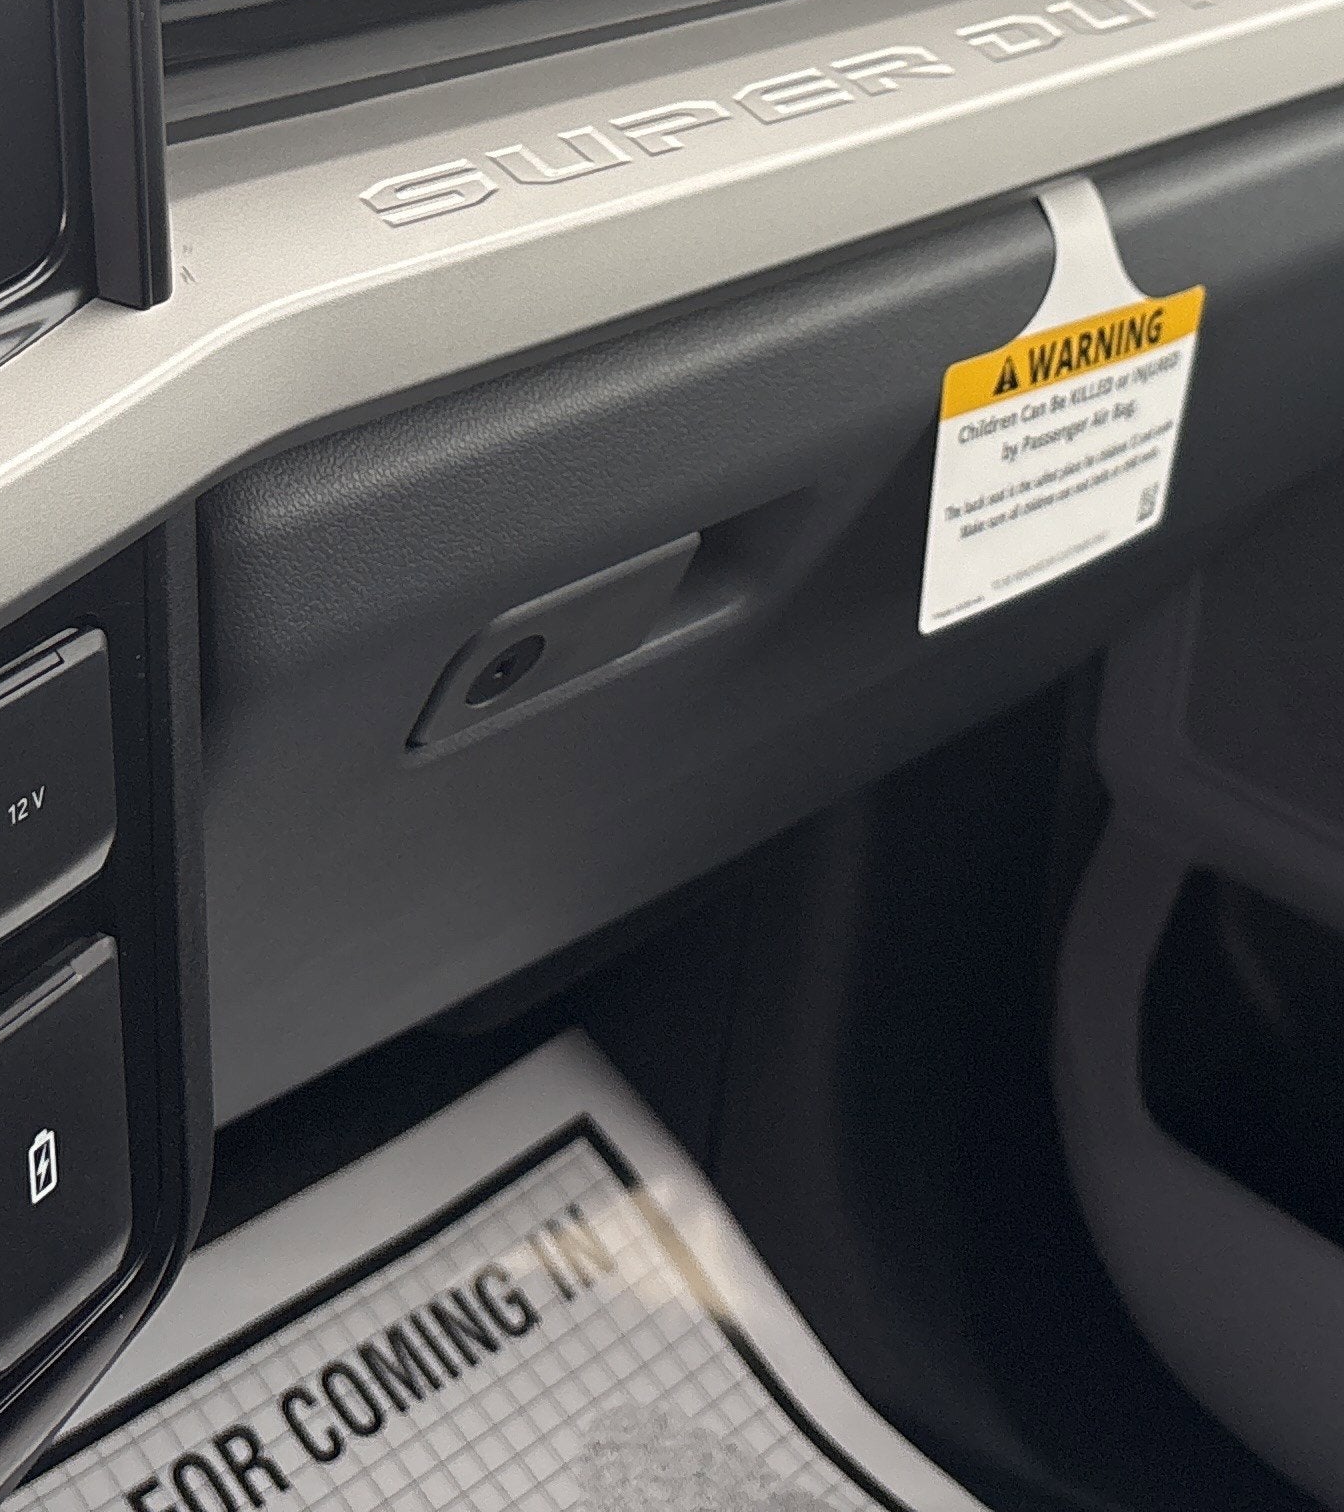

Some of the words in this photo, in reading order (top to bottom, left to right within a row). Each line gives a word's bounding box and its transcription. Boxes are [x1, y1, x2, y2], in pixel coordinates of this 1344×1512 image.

[359, 44, 956, 228] SUPER
[1028, 307, 1164, 385] WARNING
[958, 411, 1018, 445] Children
[1021, 402, 1047, 424] Can
[7, 796, 29, 825] 12
[31, 785, 45, 809] V
[280, 1260, 543, 1464] COMING
[525, 1201, 618, 1303] IN
